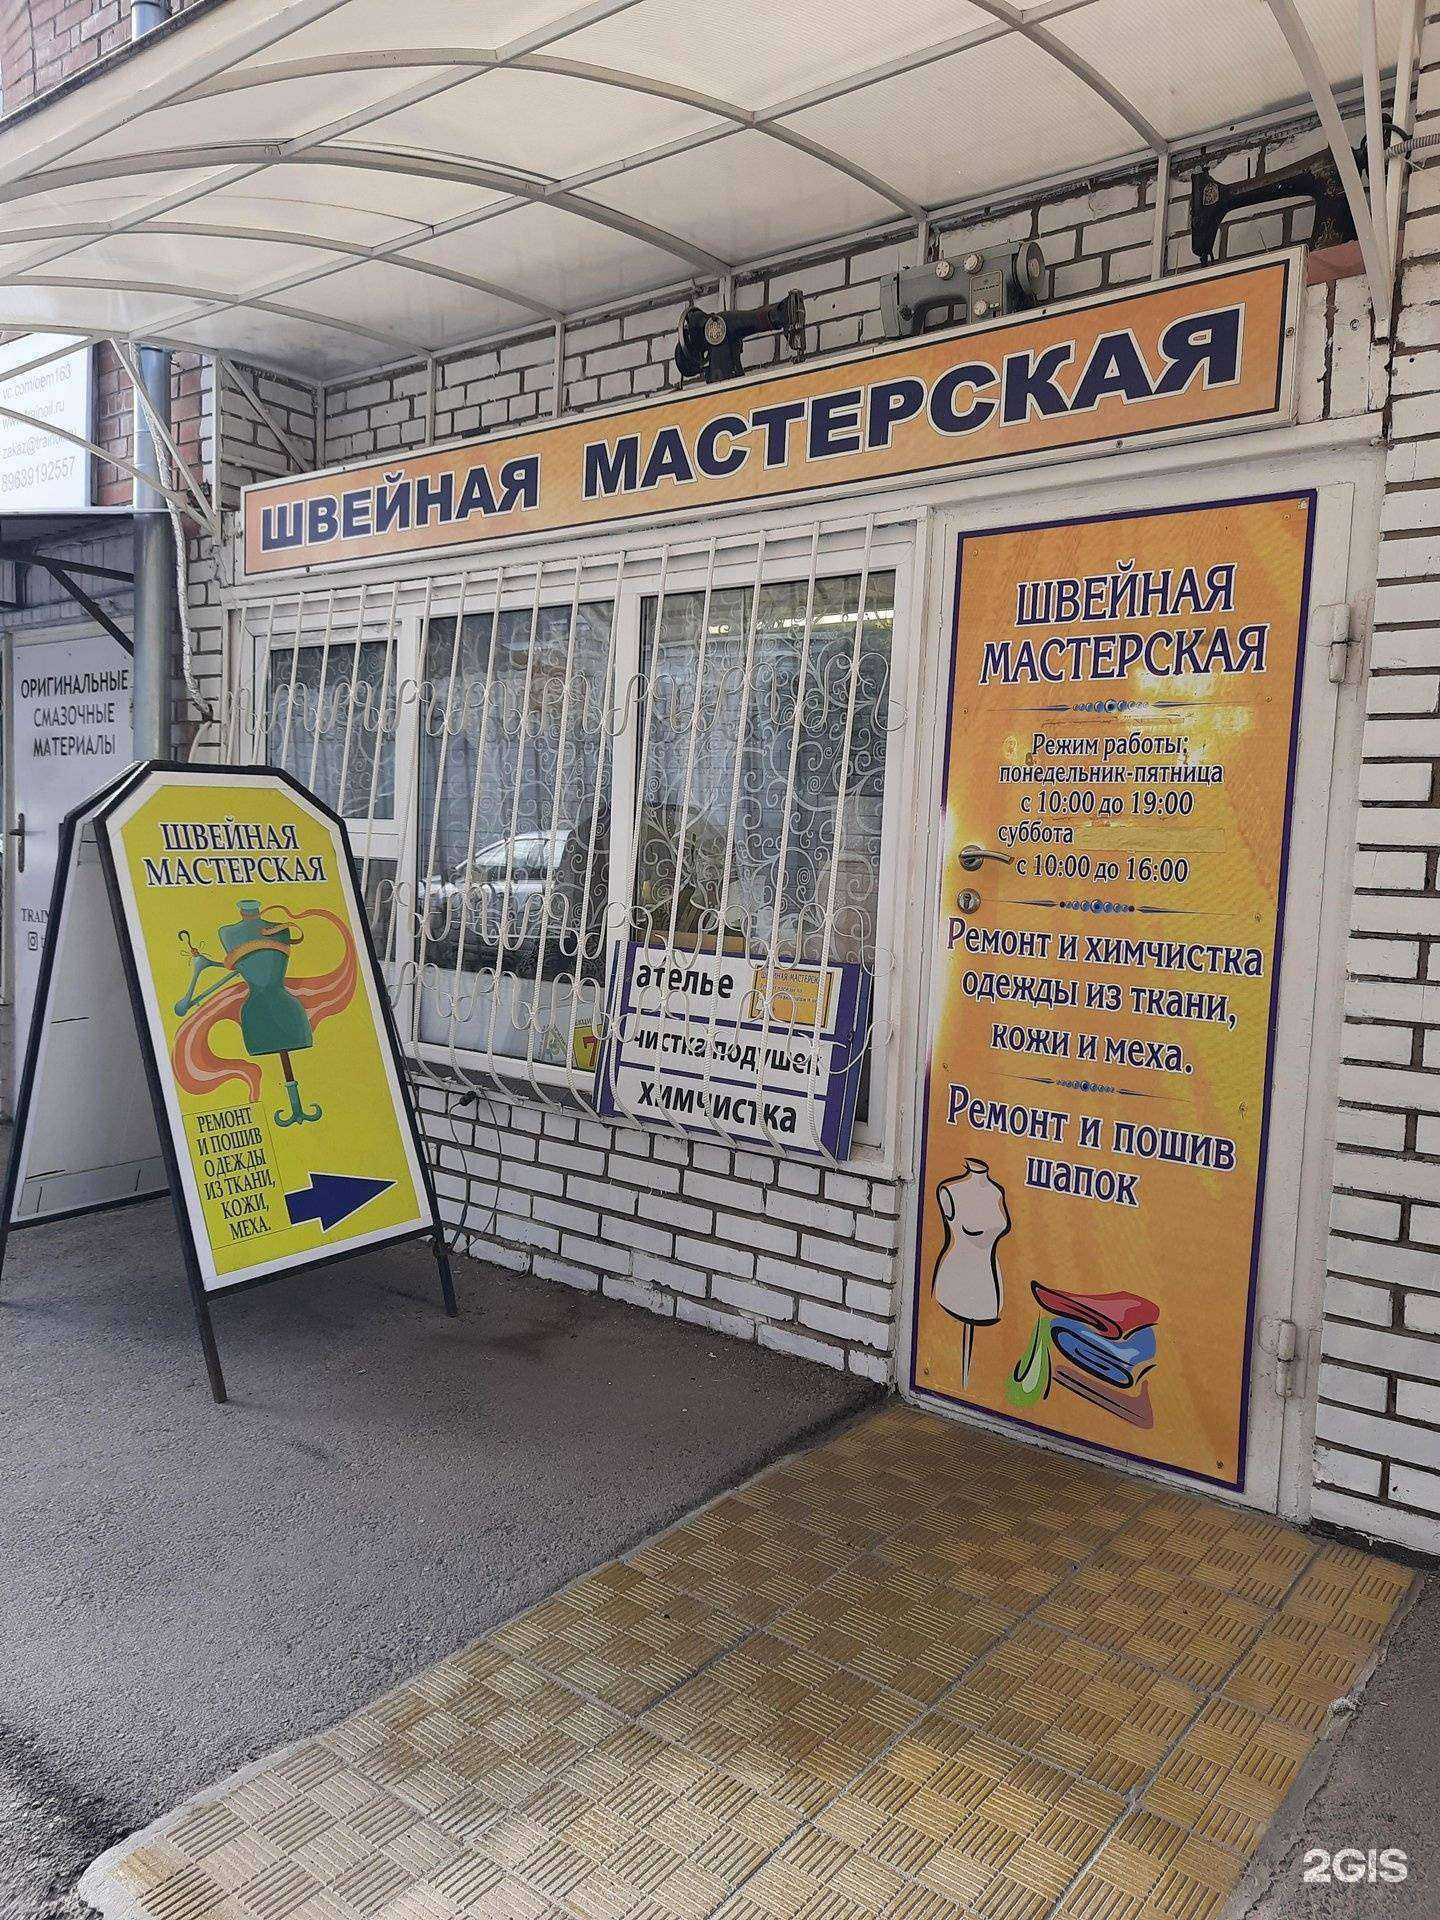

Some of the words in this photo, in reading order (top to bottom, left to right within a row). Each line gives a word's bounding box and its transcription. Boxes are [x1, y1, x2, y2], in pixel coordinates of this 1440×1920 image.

[261, 454, 541, 553] ШВЕЙНАЯ
[582, 302, 1246, 500] МАСТЕРСКАЯ
[1015, 558, 1237, 626] ШВЕЙНАЯ
[978, 623, 1270, 685] МАСТЕРСКАЯ
[20, 669, 129, 699] ОРИГИНАЛЬНЫЕ
[33, 702, 115, 728] СМАЗОЧНЫЕ
[33, 734, 116, 757] МАТЕРИАЛЫ
[1032, 733, 1097, 756] Режим
[999, 764, 1224, 786] понедельник-пятница
[1020, 795, 1031, 813] с
[1038, 790, 1095, 814] 10:00
[1098, 795, 1124, 816] до
[1131, 790, 1194, 816] 19:00
[160, 816, 300, 851] ШВЕЙНАЯ
[998, 821, 1075, 848] суббота
[143, 856, 328, 886] МАСТЕРСКАЯ
[1016, 859, 1027, 876] с
[1033, 854, 1091, 878] 10:00
[1094, 862, 1119, 882] до
[1126, 857, 1189, 883] 16:00
[947, 917, 1051, 960] Ремонт
[1058, 934, 1078, 961] и
[1083, 936, 1264, 977] химчистка
[636, 964, 734, 999] ателье
[961, 969, 1078, 1010] одежды
[1085, 982, 1122, 1011] из
[1130, 987, 1238, 1031] ткани,
[634, 1029, 705, 1058] чистка
[712, 1040, 821, 1077] подушек
[990, 1024, 1070, 1059] кожи
[1077, 1033, 1097, 1062] и
[1104, 1036, 1194, 1075] меха.
[196, 1107, 253, 1133] РЕМОНТ
[637, 1081, 797, 1134] химчистка
[196, 1137, 208, 1156] И
[210, 1127, 263, 1153] ПОШИВ
[947, 1083, 1068, 1143] Ремонт
[1078, 1115, 1102, 1150] и
[1113, 1120, 1235, 1172] пошив
[204, 1148, 267, 1178] ОДЕЖДЫ
[204, 1180, 224, 1200] ИЗ
[224, 1168, 276, 1195] ТКАНИ,
[1025, 1156, 1140, 1207] шапок
[221, 1193, 269, 1219] КОЖИ,
[229, 1215, 271, 1240] МЕХА.
